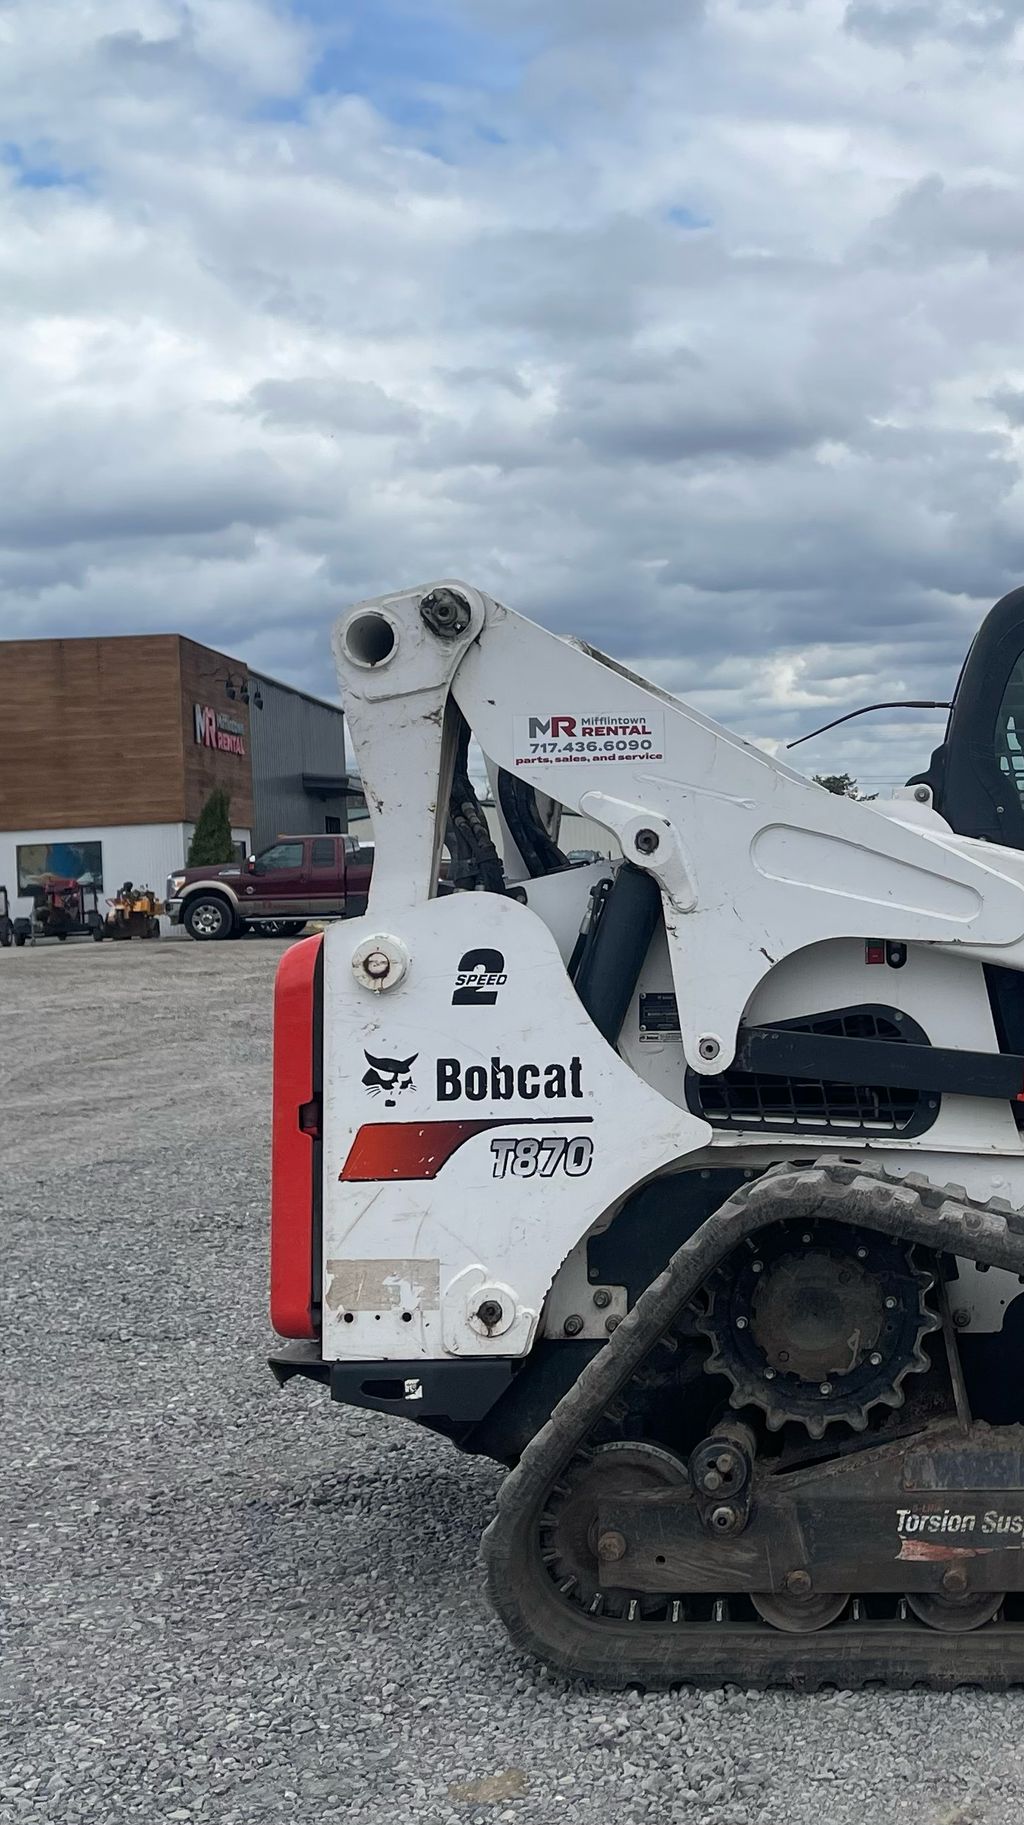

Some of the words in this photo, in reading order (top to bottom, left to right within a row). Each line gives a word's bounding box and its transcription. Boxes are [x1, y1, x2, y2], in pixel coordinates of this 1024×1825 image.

[195, 703, 217, 748] MR
[528, 715, 577, 739] MR
[581, 716, 646, 726] Mifflintown
[581, 725, 652, 737] RENTAL
[217, 732, 246, 755] RENTAL
[529, 739, 653, 754] 717.436.6090
[515, 756, 553, 766] parts,
[554, 754, 590, 763] sales,
[592, 753, 616, 761] and
[617, 752, 663, 761] service
[452, 948, 505, 1006] 2
[455, 974, 508, 986] SPEED
[436, 1056, 584, 1101] Bobcat
[490, 1136, 594, 1179] T870
[896, 1509, 976, 1533] Torsion
